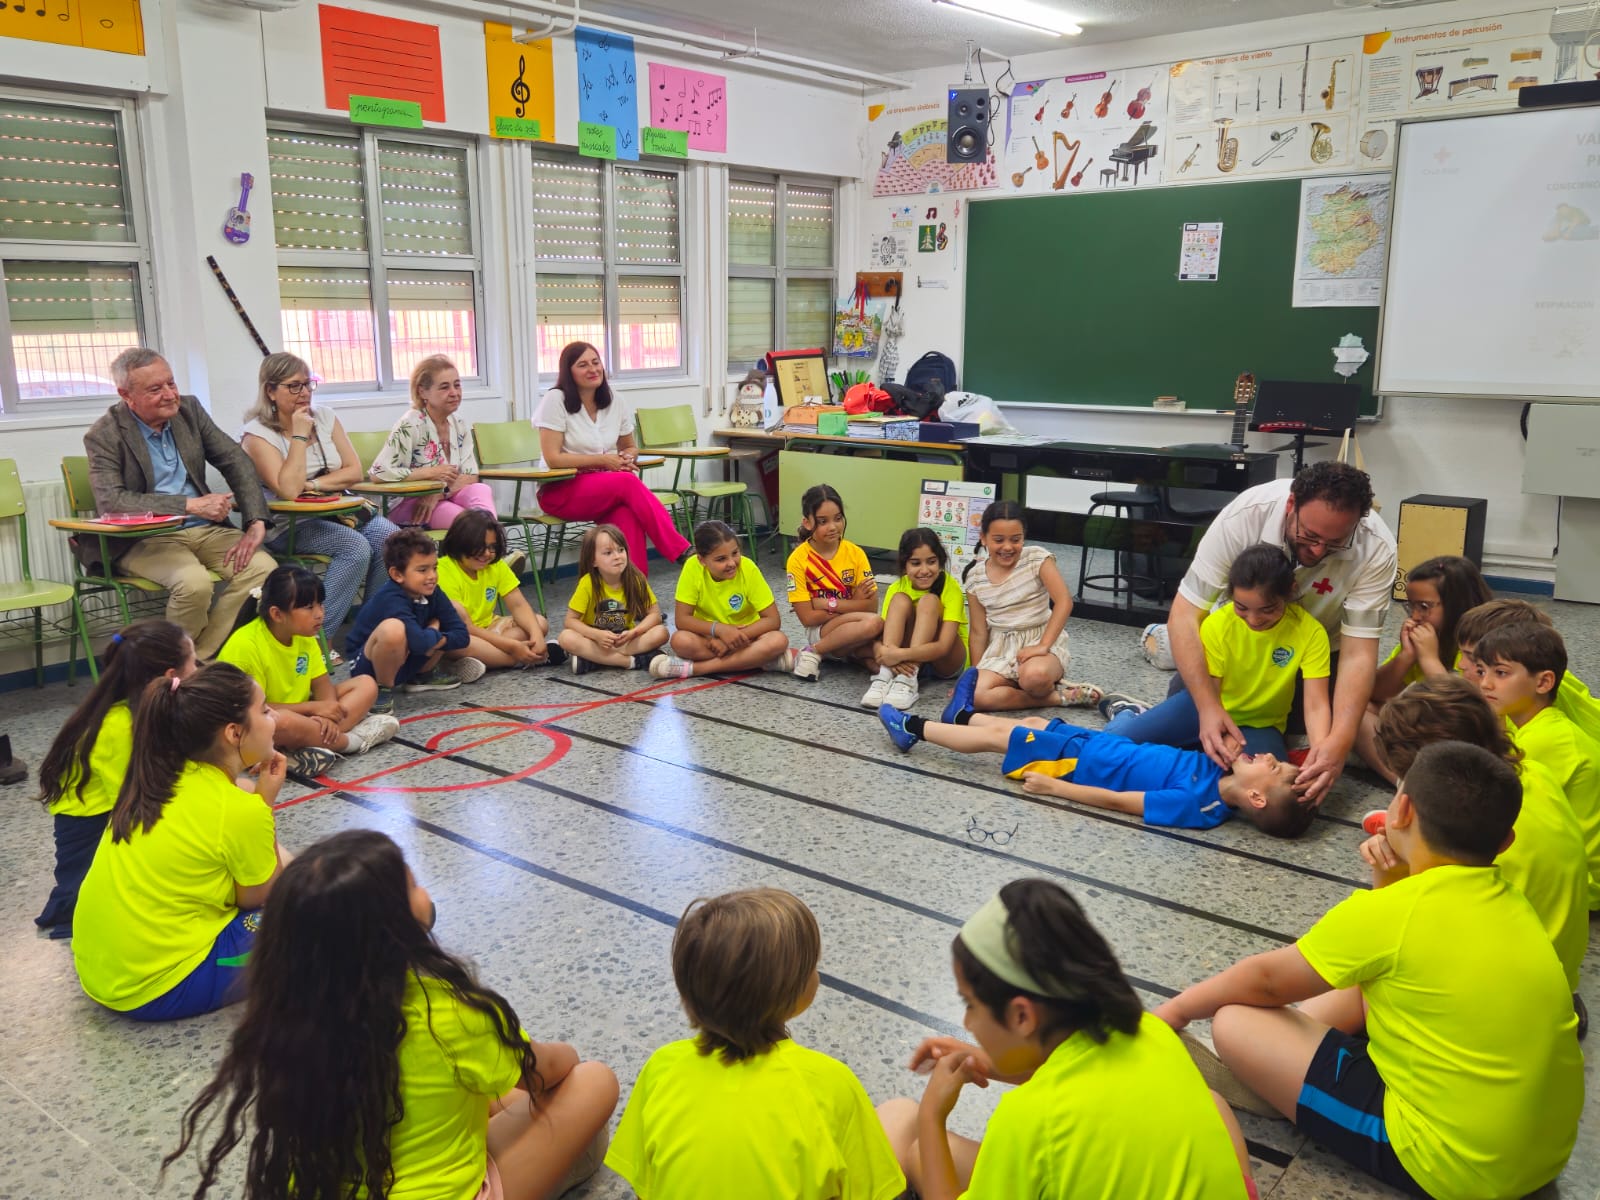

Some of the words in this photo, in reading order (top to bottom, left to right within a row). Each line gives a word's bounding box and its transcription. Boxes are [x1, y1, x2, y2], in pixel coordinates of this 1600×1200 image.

[1394, 30, 1447, 44] Instrumentos
[1449, 28, 1460, 37] de
[1462, 22, 1503, 36] percusión
[1251, 50, 1273, 60] viento
